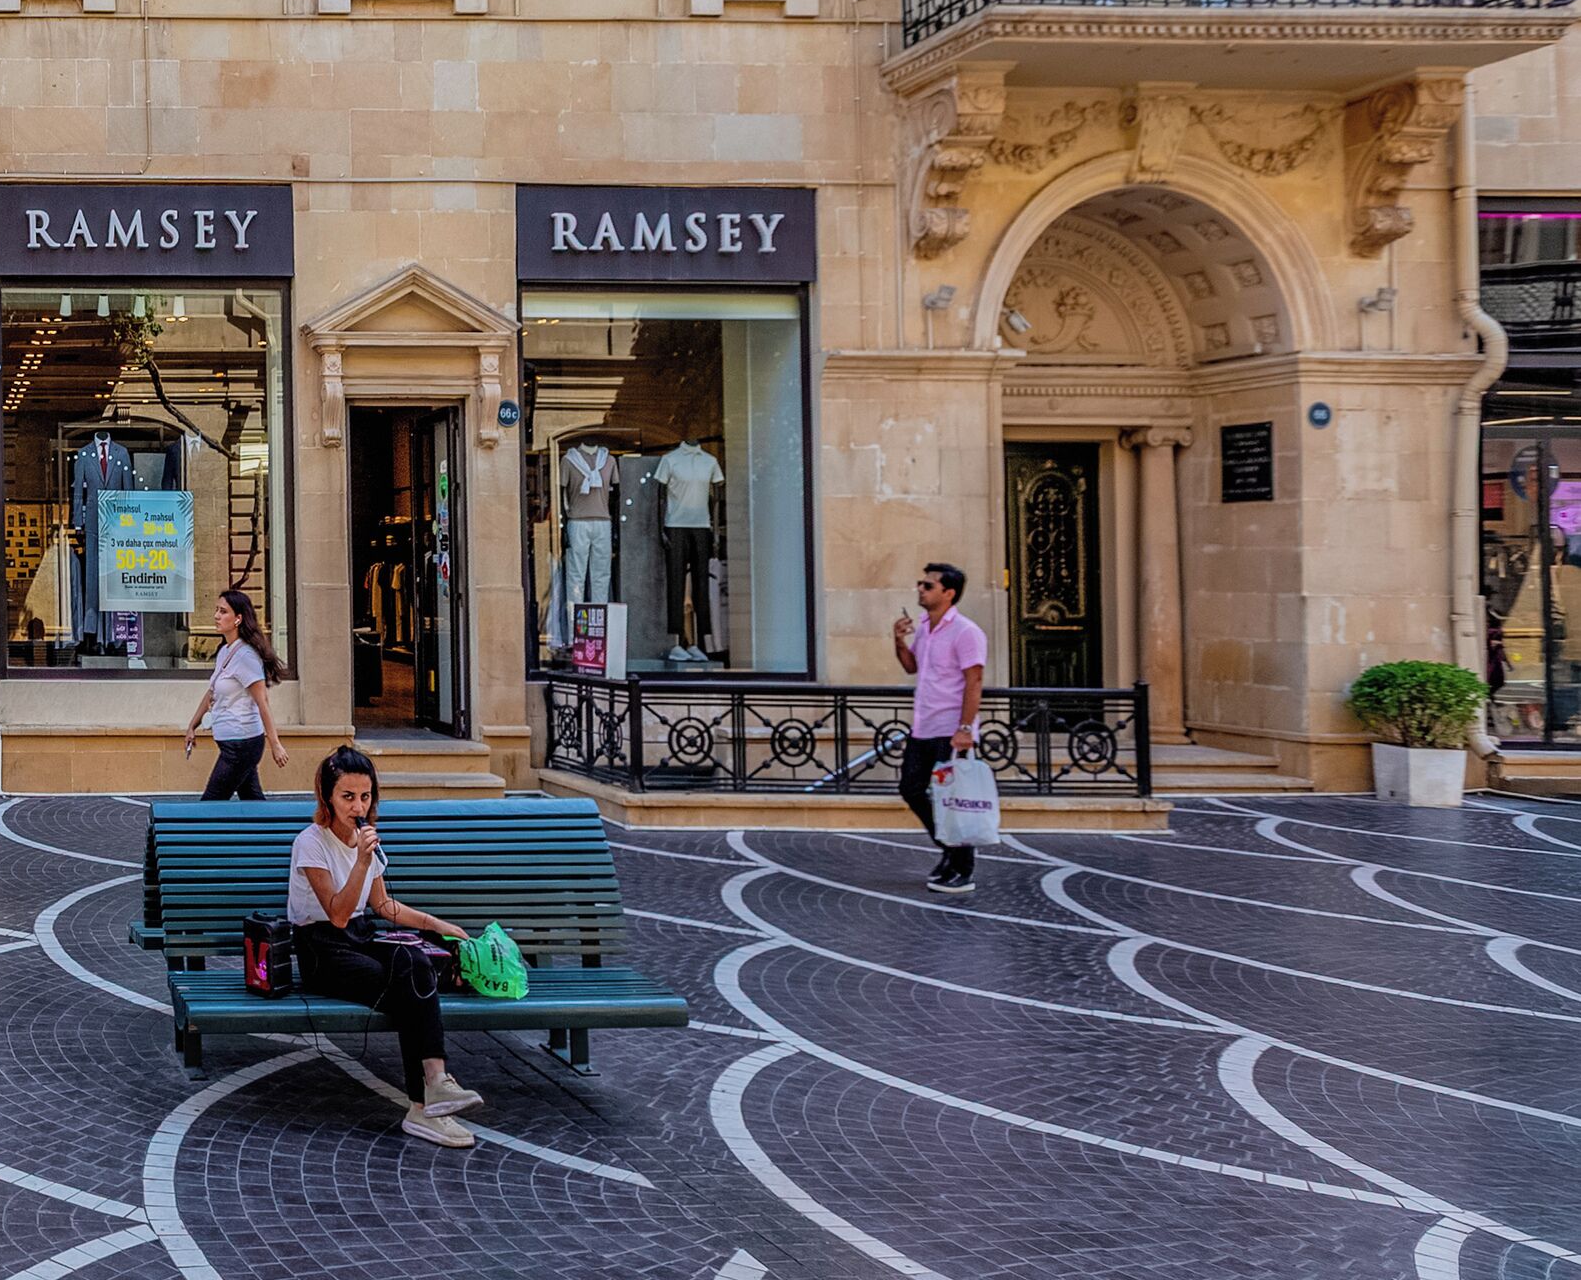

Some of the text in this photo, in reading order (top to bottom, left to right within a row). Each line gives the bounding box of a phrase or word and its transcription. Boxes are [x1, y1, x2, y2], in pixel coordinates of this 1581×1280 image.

[25, 208, 258, 249] RAMSEY
[550, 211, 785, 254] RAMSEY
[144, 512, 149, 522] 2
[111, 538, 116, 547] 3
[125, 538, 141, 547] daha
[121, 572, 167, 584] Endirim
